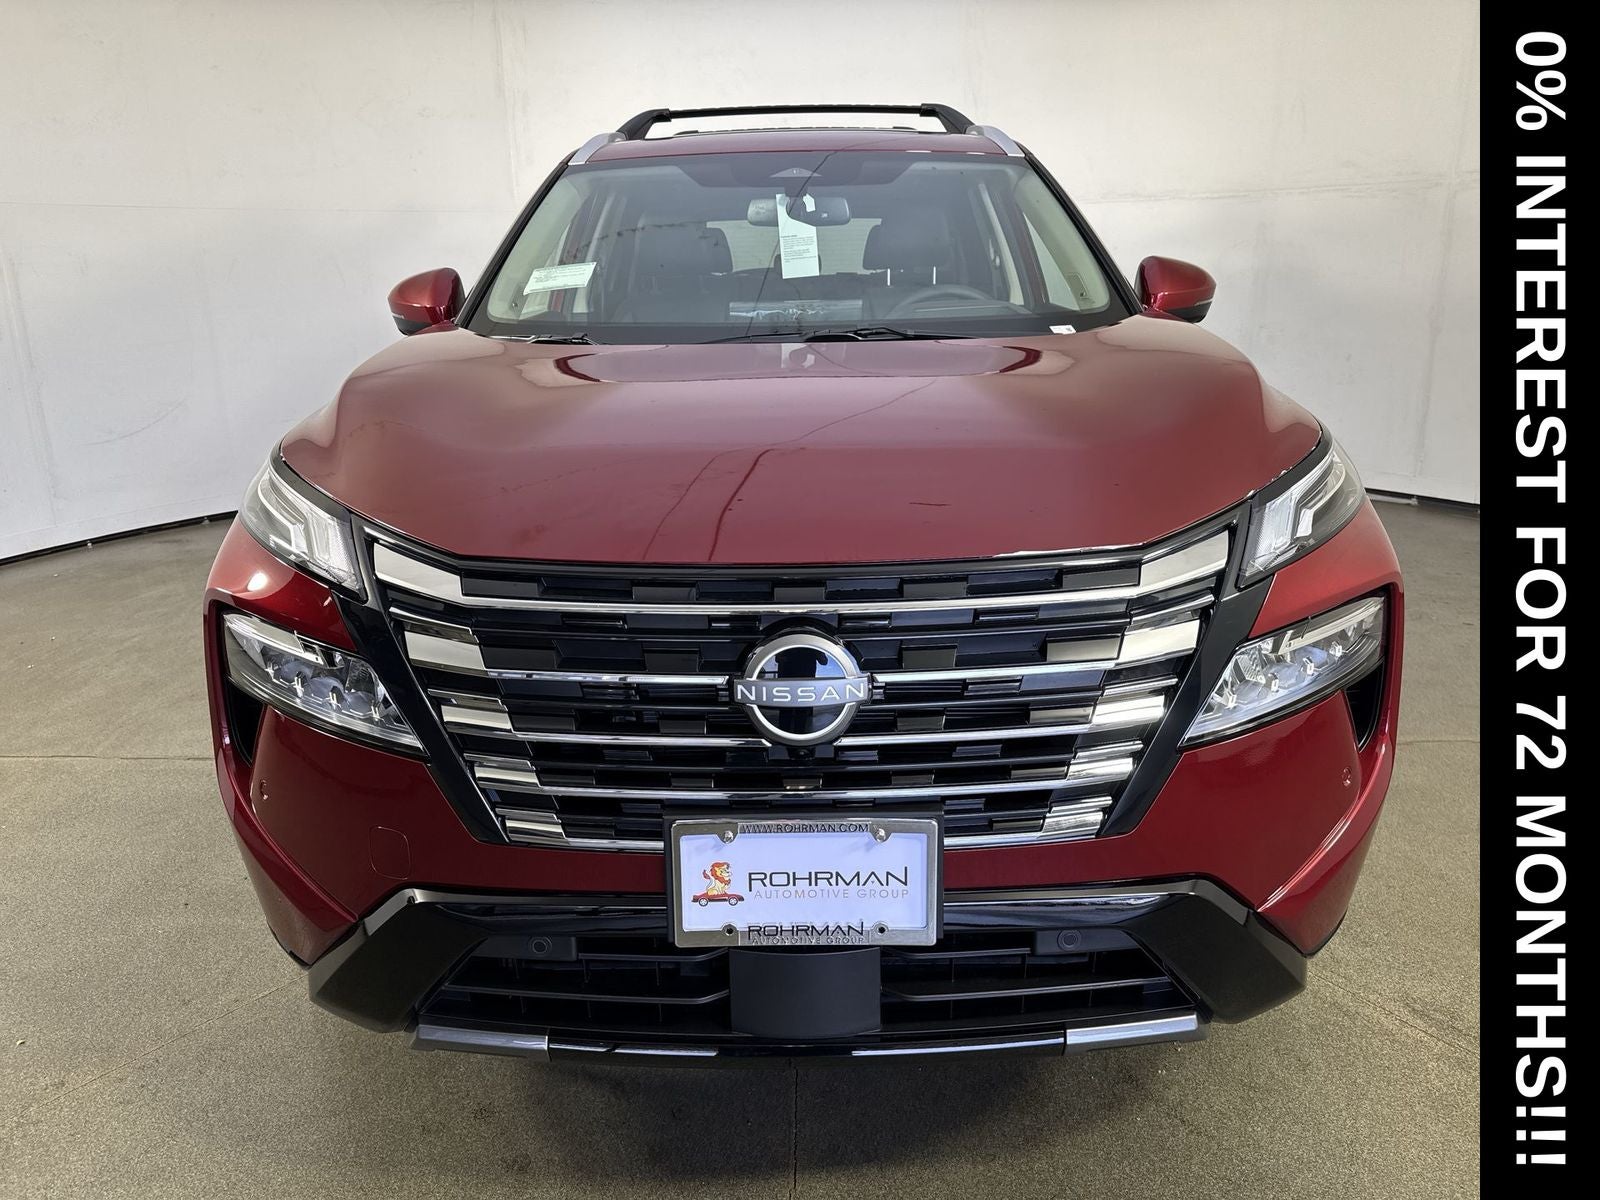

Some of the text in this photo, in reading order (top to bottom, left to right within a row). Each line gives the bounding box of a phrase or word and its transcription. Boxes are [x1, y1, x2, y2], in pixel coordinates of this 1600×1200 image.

[737, 682, 865, 702] NISSAN
[741, 823, 869, 834] WWW.ROHRMAN.COM
[748, 866, 908, 892] ROHRMAN
[754, 889, 909, 899] AUTOMOTIVE GROUP
[747, 920, 864, 940] ROHRMAN
[826, 936, 864, 945] GROUP
